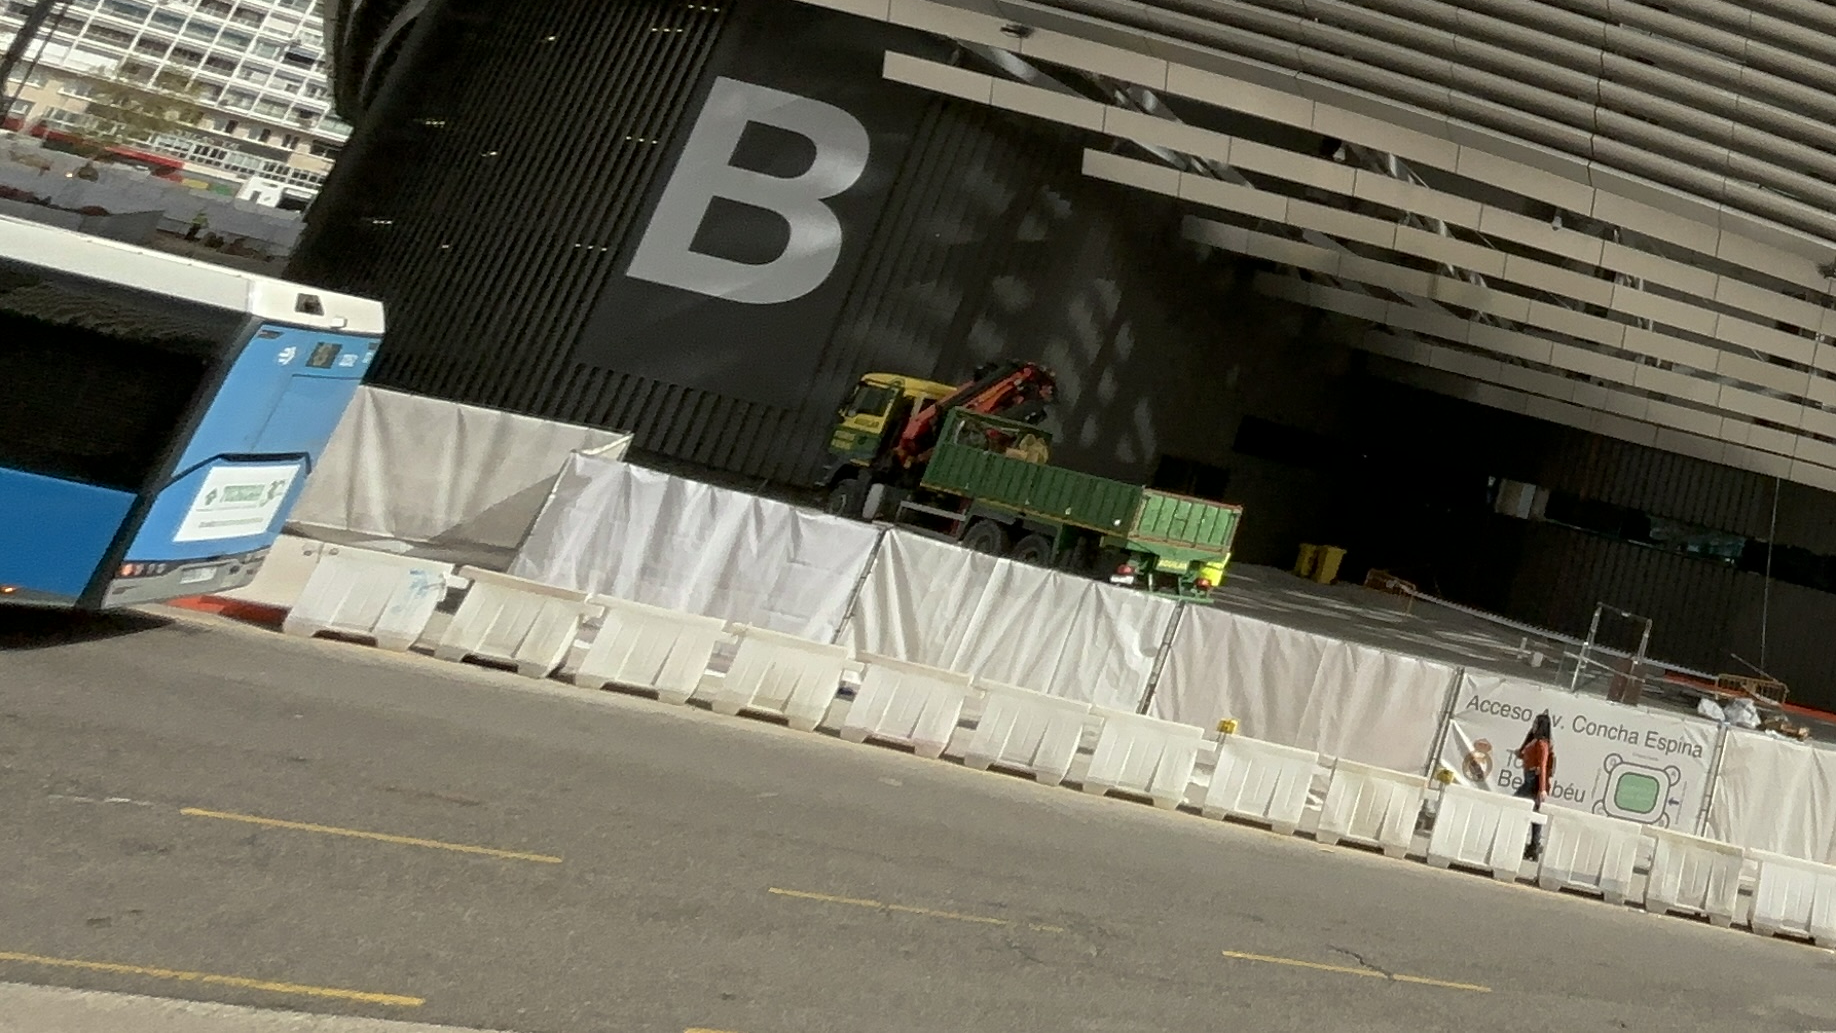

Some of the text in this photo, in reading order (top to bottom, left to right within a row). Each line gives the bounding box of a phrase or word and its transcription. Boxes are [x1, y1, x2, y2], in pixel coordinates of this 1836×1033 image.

[626, 75, 870, 304] B
[1466, 694, 1533, 722] Acceso
[1572, 714, 1639, 745] Concha
[1644, 730, 1703, 759] Espina
